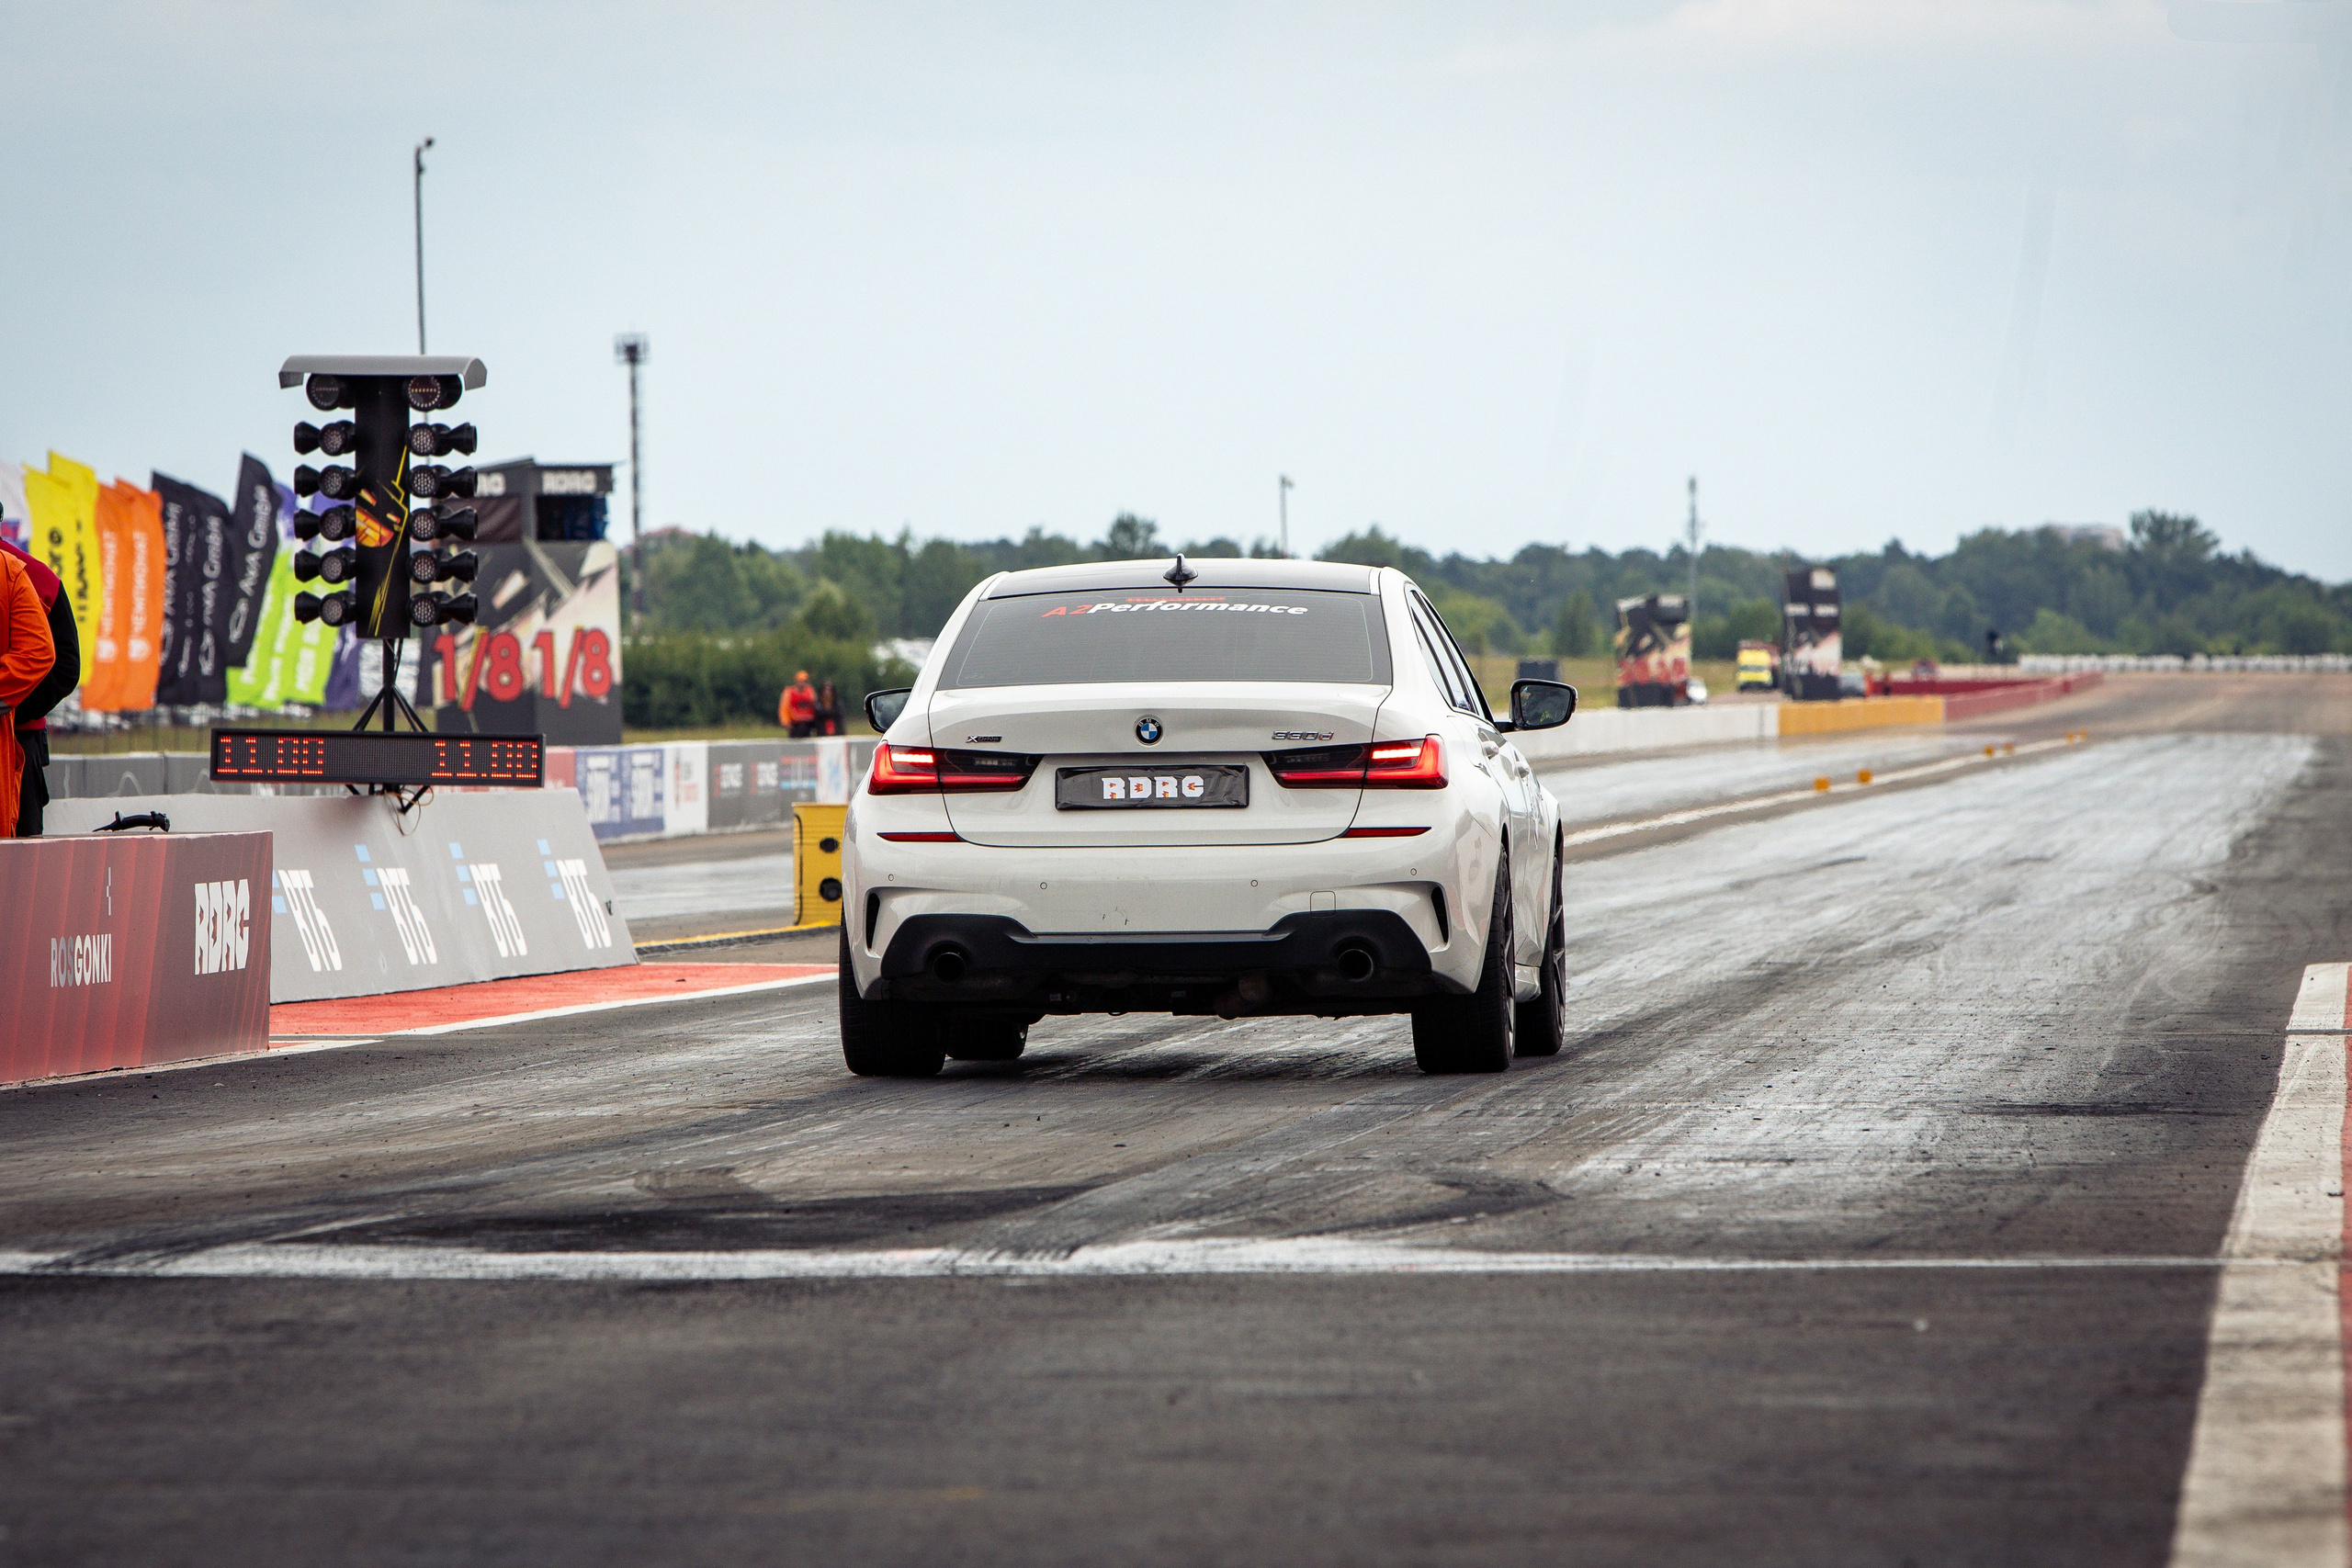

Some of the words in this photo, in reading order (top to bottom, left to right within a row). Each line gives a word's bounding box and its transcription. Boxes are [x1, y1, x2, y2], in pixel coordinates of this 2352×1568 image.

[435, 627, 523, 711] 1/8
[533, 625, 612, 709] 1/8
[217, 737, 324, 773] 11.00
[1272, 730, 1334, 740] 330d
[432, 740, 537, 778] 11.00
[51, 933, 112, 988] ROSGONKI
